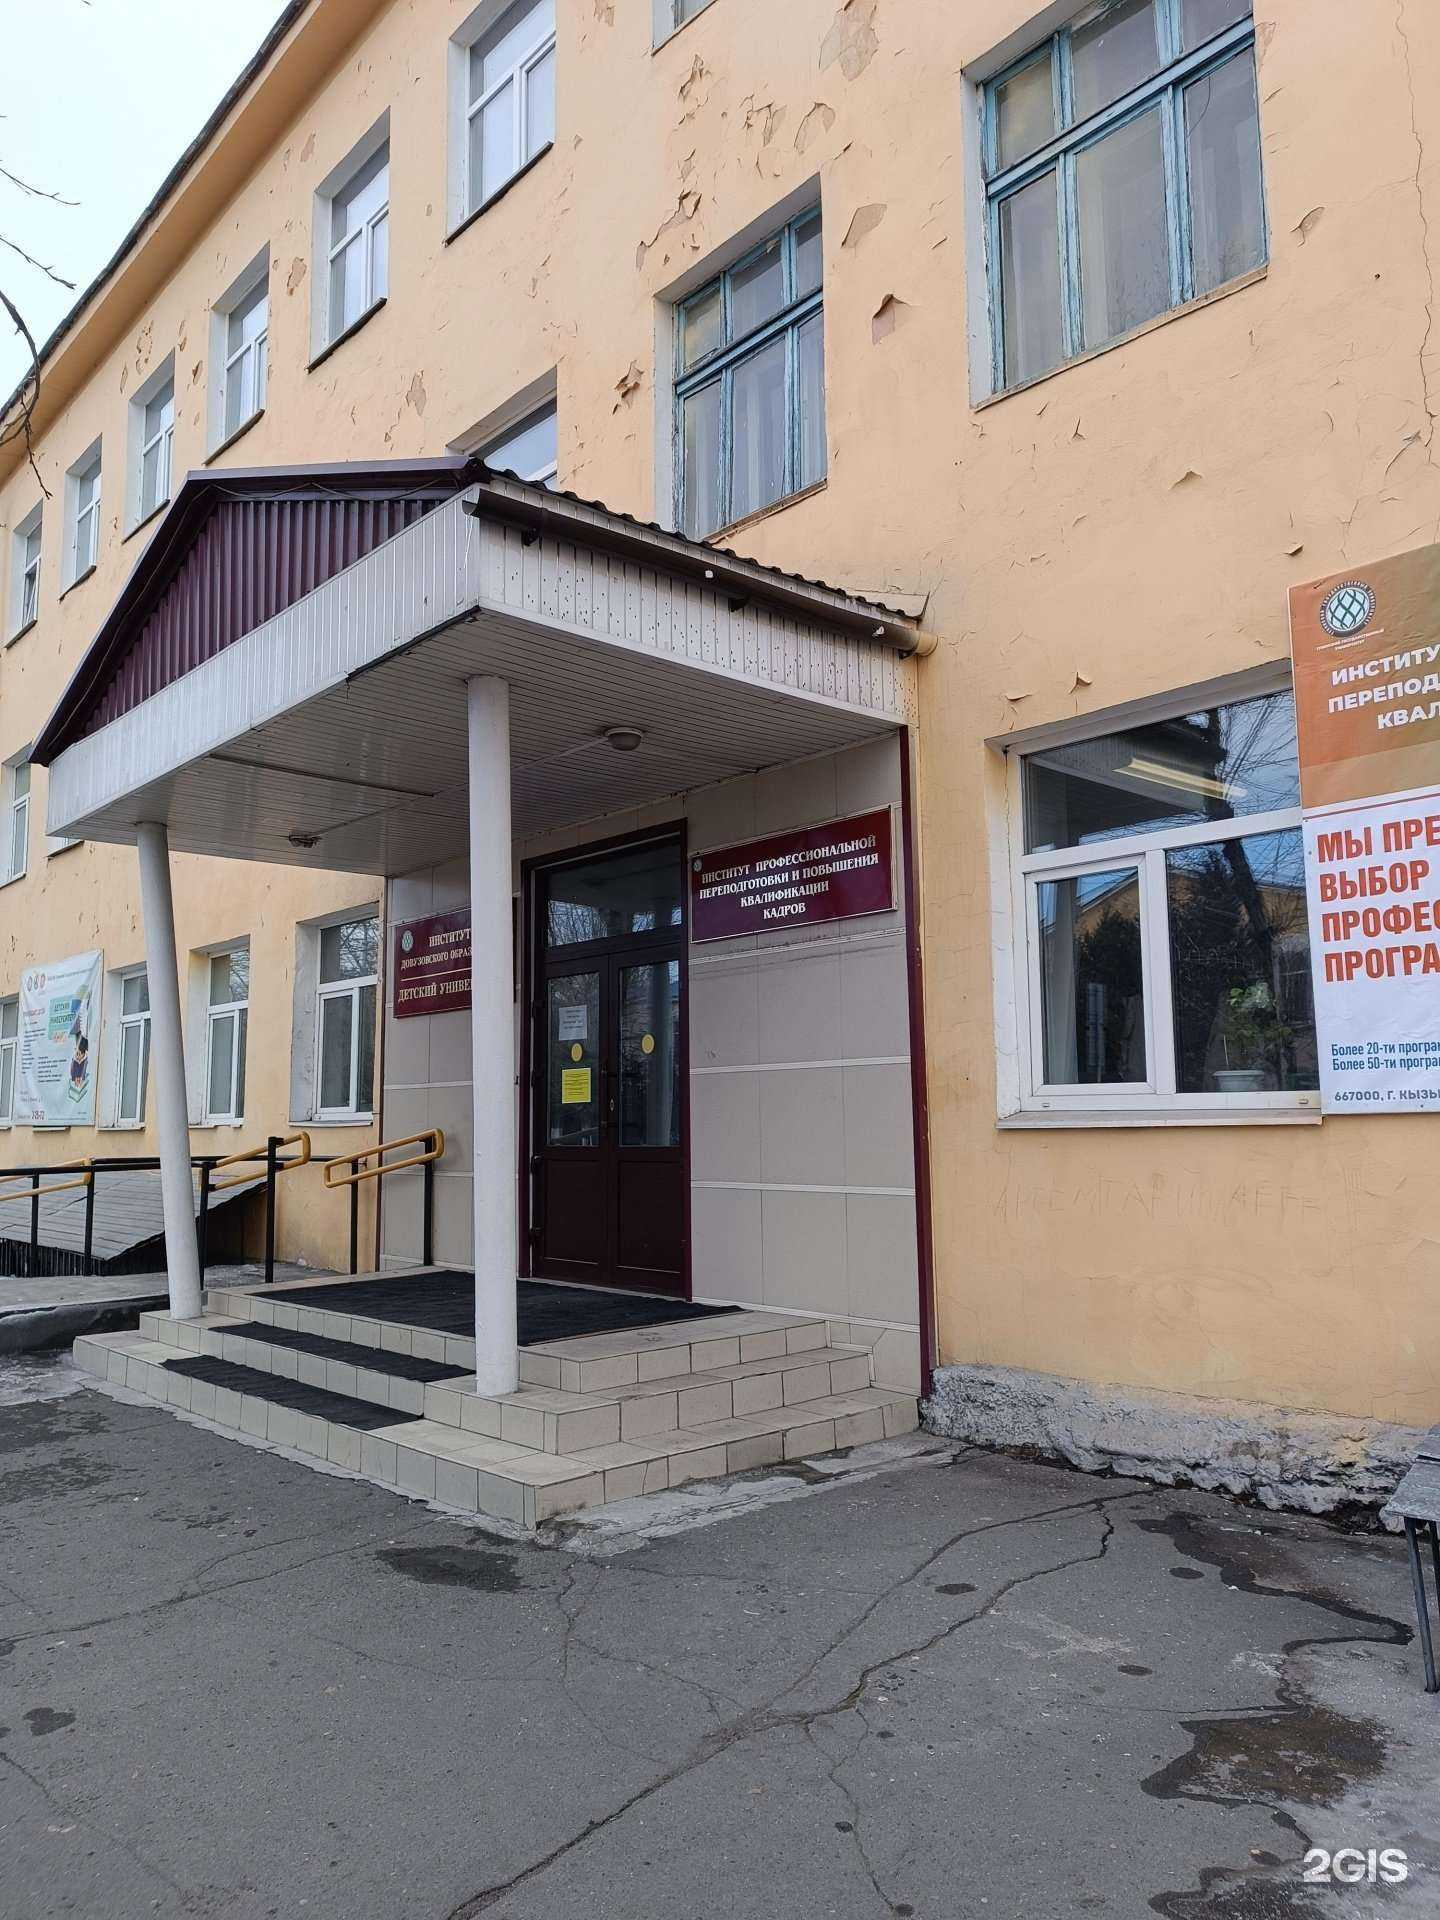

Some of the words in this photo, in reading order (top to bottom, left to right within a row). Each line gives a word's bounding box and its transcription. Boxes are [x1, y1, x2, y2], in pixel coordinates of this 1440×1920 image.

[1331, 643, 1440, 687] ИНСТИТУ
[1328, 672, 1440, 714] ПЕРЕПОД
[1317, 827, 1373, 863] МЫ
[1382, 815, 1440, 853] ПРЕ
[702, 864, 750, 884] ИНСТИТУТ
[755, 834, 876, 872] ПРОФЕССИОНАЛЬНОЙ
[699, 871, 789, 900] ПЕРЕПОДГОТОВКИ
[792, 869, 800, 881] И
[802, 853, 879, 879] ПОВЫШЕНИЯ
[1319, 859, 1430, 903] ВЫБОР
[740, 880, 829, 907] КВАЛИФИКАЦИИ
[763, 902, 806, 920] КАДРОВ
[429, 928, 471, 947] ИНСТИТУТ
[401, 952, 448, 970] ДОВУЗОВСКОГО
[1324, 942, 1440, 983] ПРОГРА
[398, 983, 436, 1003] ДЕТСКИЙ
[1331, 1043, 1364, 1056] Более
[1366, 1041, 1396, 1055] 20-ти
[1332, 1058, 1365, 1071] Более
[1367, 1056, 1397, 1070] 50-ти
[1400, 1056, 1440, 1071] програ
[1334, 1091, 1384, 1102] 667000,
